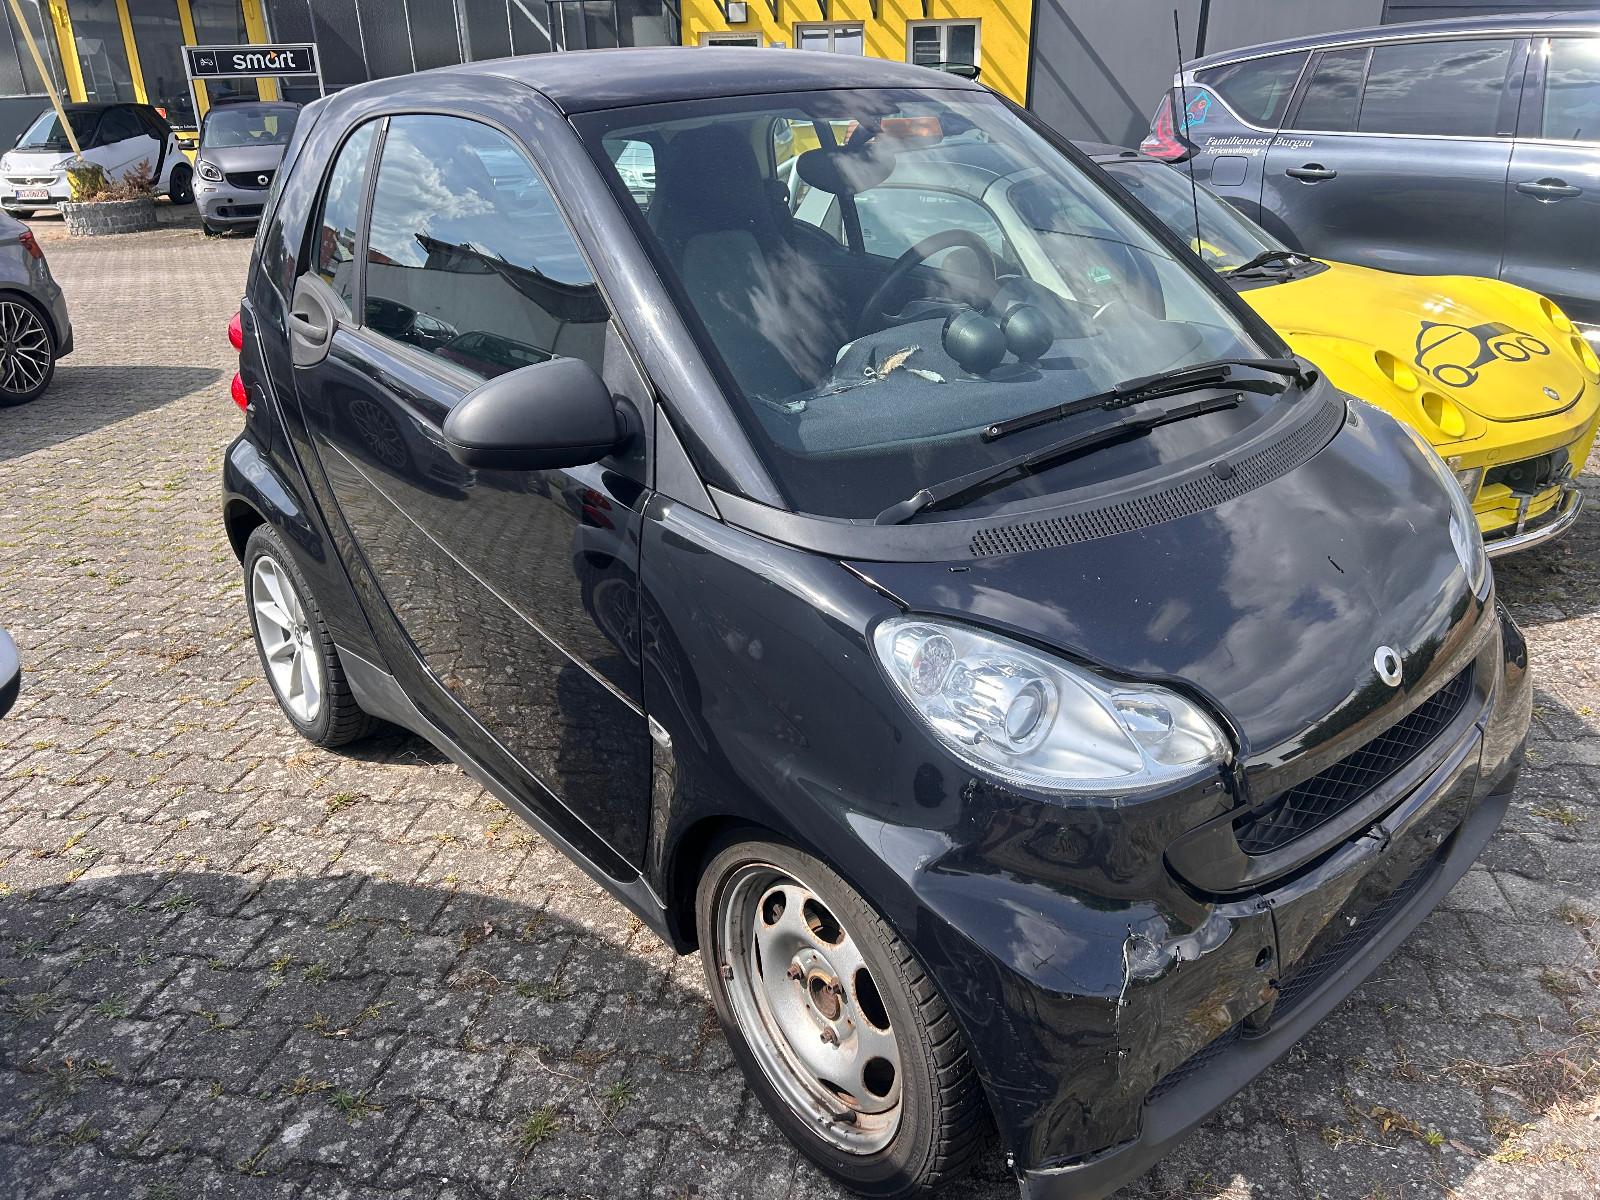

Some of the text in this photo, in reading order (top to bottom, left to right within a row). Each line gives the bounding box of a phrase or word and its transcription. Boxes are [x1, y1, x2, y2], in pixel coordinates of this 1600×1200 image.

[232, 50, 296, 70] smart
[1205, 136, 1314, 149] Familiennest Burgau
